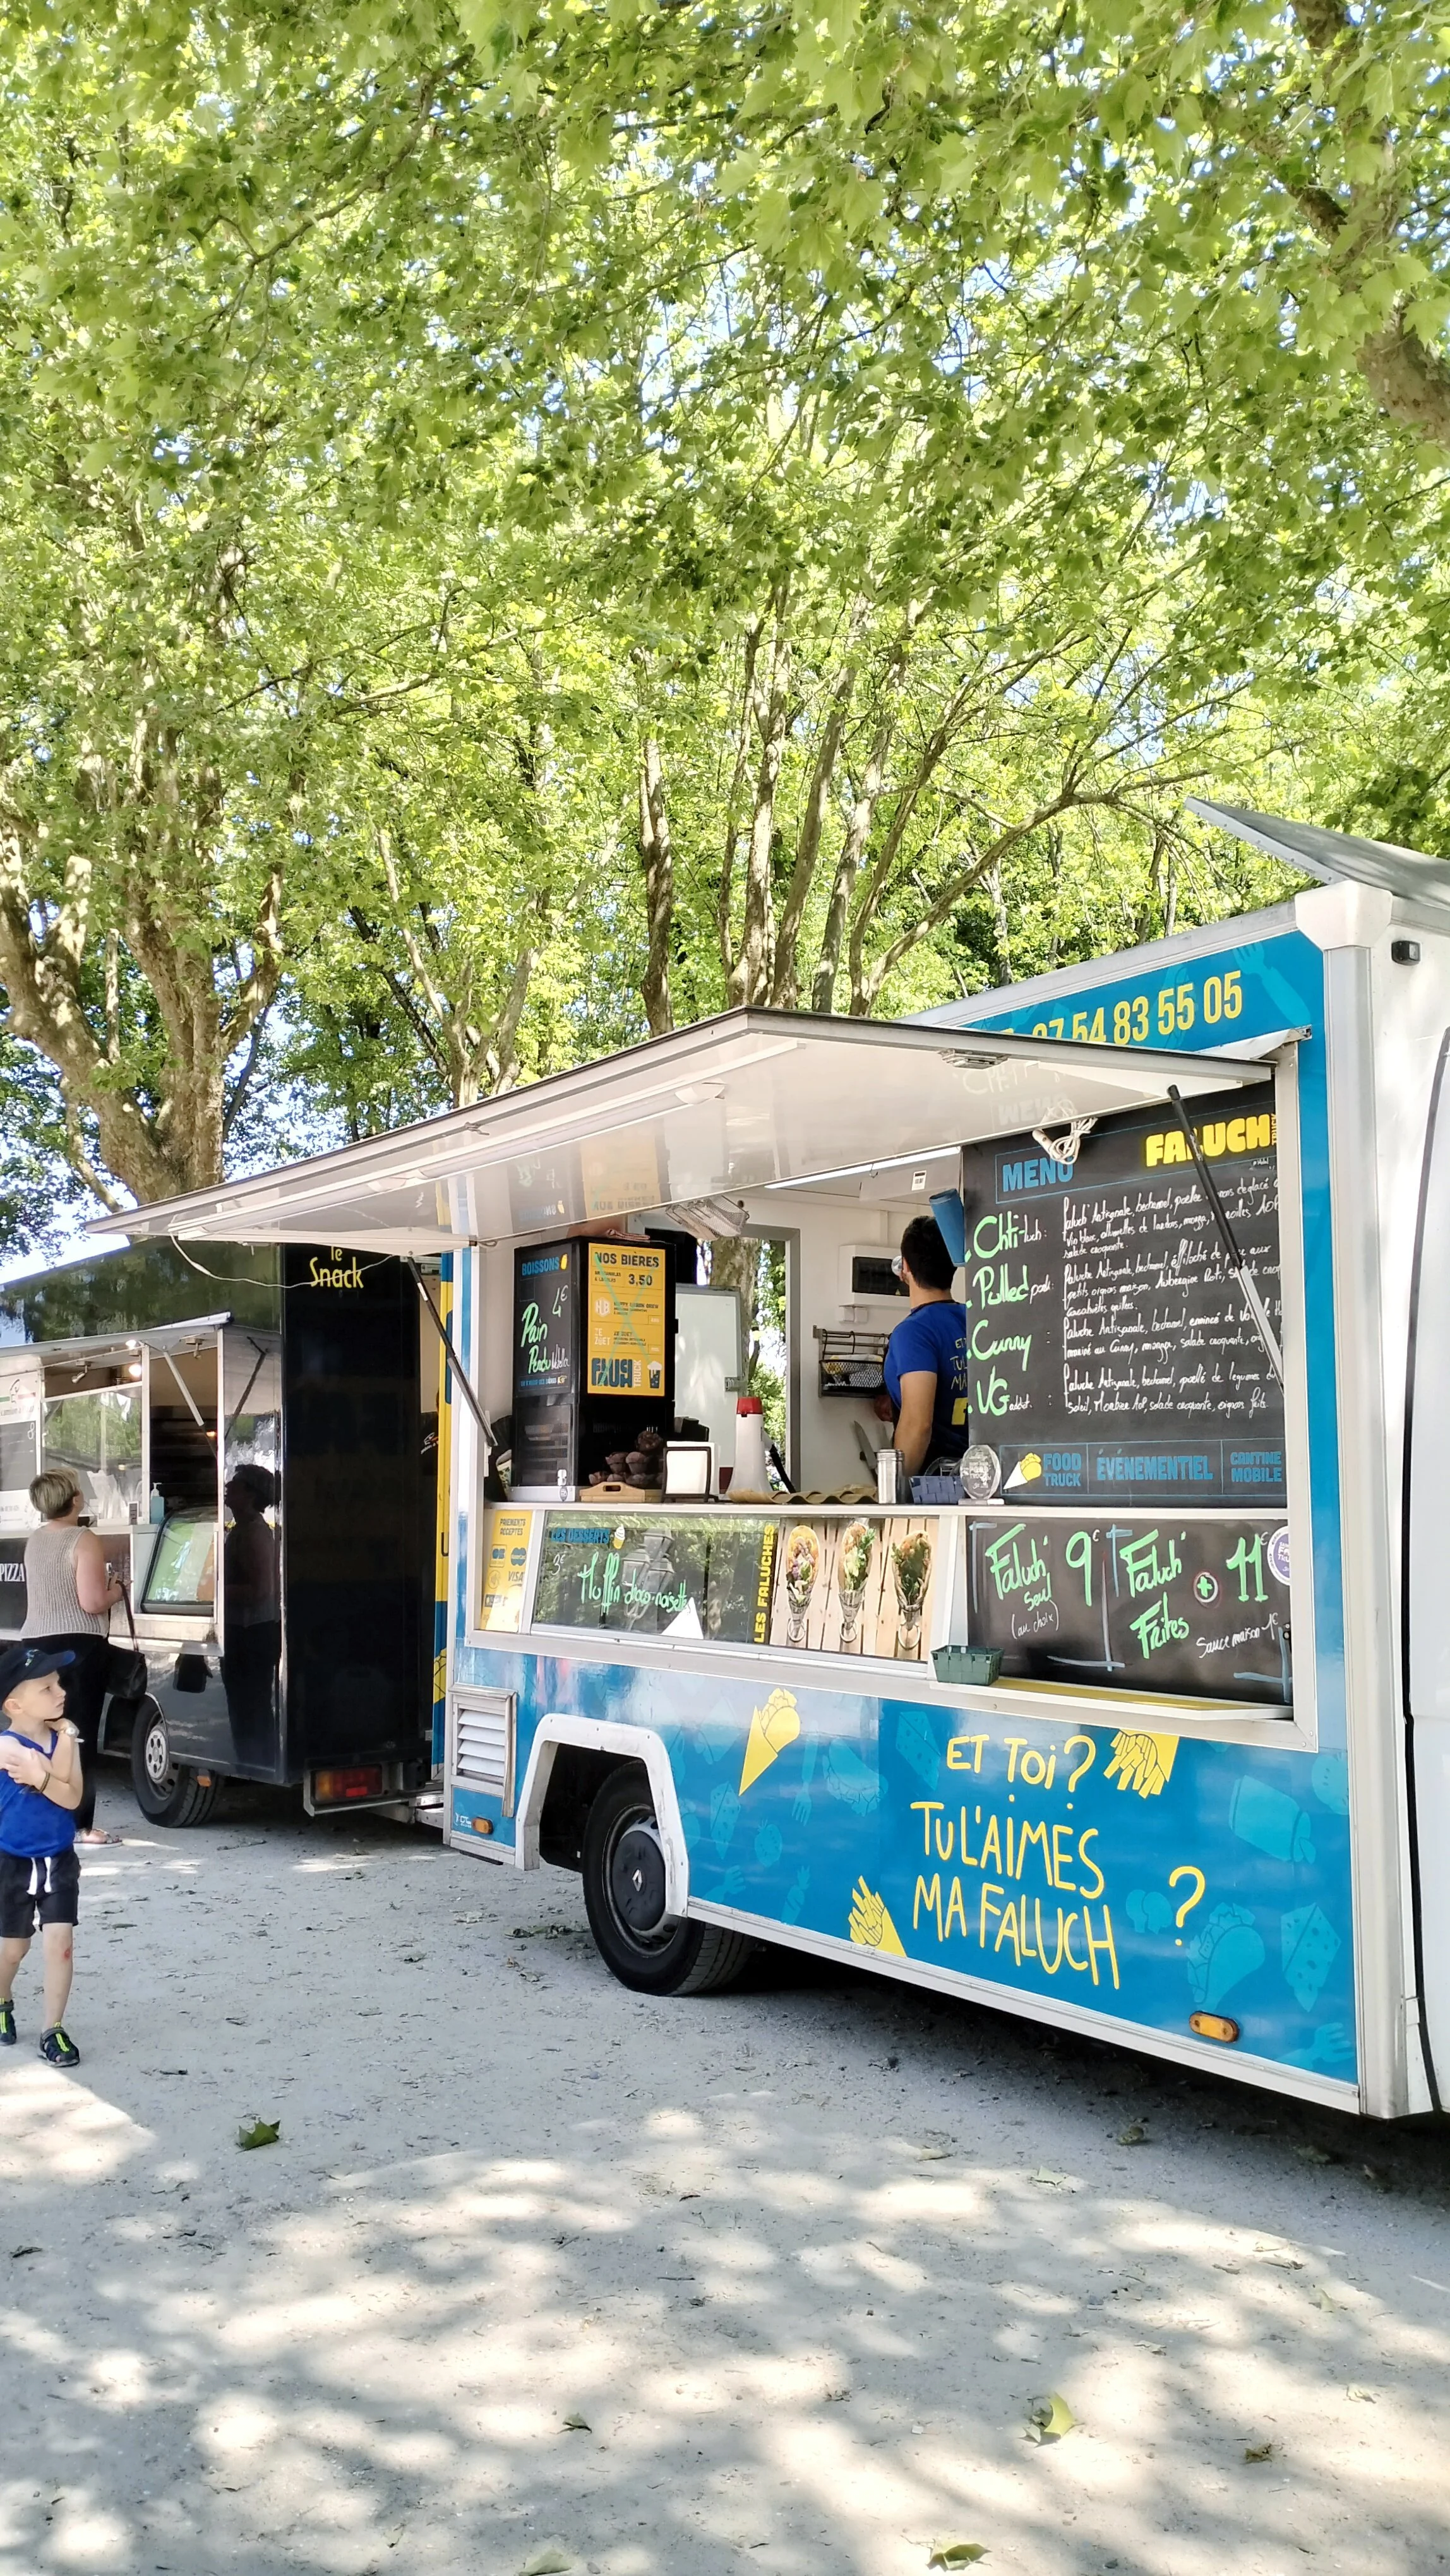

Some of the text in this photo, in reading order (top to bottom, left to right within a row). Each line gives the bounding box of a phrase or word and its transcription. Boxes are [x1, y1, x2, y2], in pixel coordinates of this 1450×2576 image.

[1114, 996, 1149, 1045] 83
[1158, 984, 1194, 1034] 55
[1204, 970, 1242, 1023] 05
[1002, 1155, 1074, 1193] MENU
[331, 1246, 342, 1261] le
[594, 1251, 659, 1268] NOS BIÈRES
[309, 1256, 364, 1289] Snack
[522, 1257, 559, 1275] BOISSONS
[628, 1273, 652, 1286] 3,50
[973, 1263, 1028, 1309] Pulled
[1043, 1449, 1282, 1480] FOOD ÉVÉNEMENTIEL CANTINE
[1044, 1468, 1282, 1487] TRUCK MOBILE
[500, 1518, 525, 1527] PAIEMENTS
[568, 1527, 610, 1544] DESSERTS
[0, 1563, 25, 1582] PIZZA
[508, 1571, 524, 1582] VISA
[753, 1524, 775, 1643] LES FALUCHES
[946, 1734, 990, 1774] ET
[913, 1873, 967, 1942] MA
[979, 1882, 1120, 1990] FALUCH
